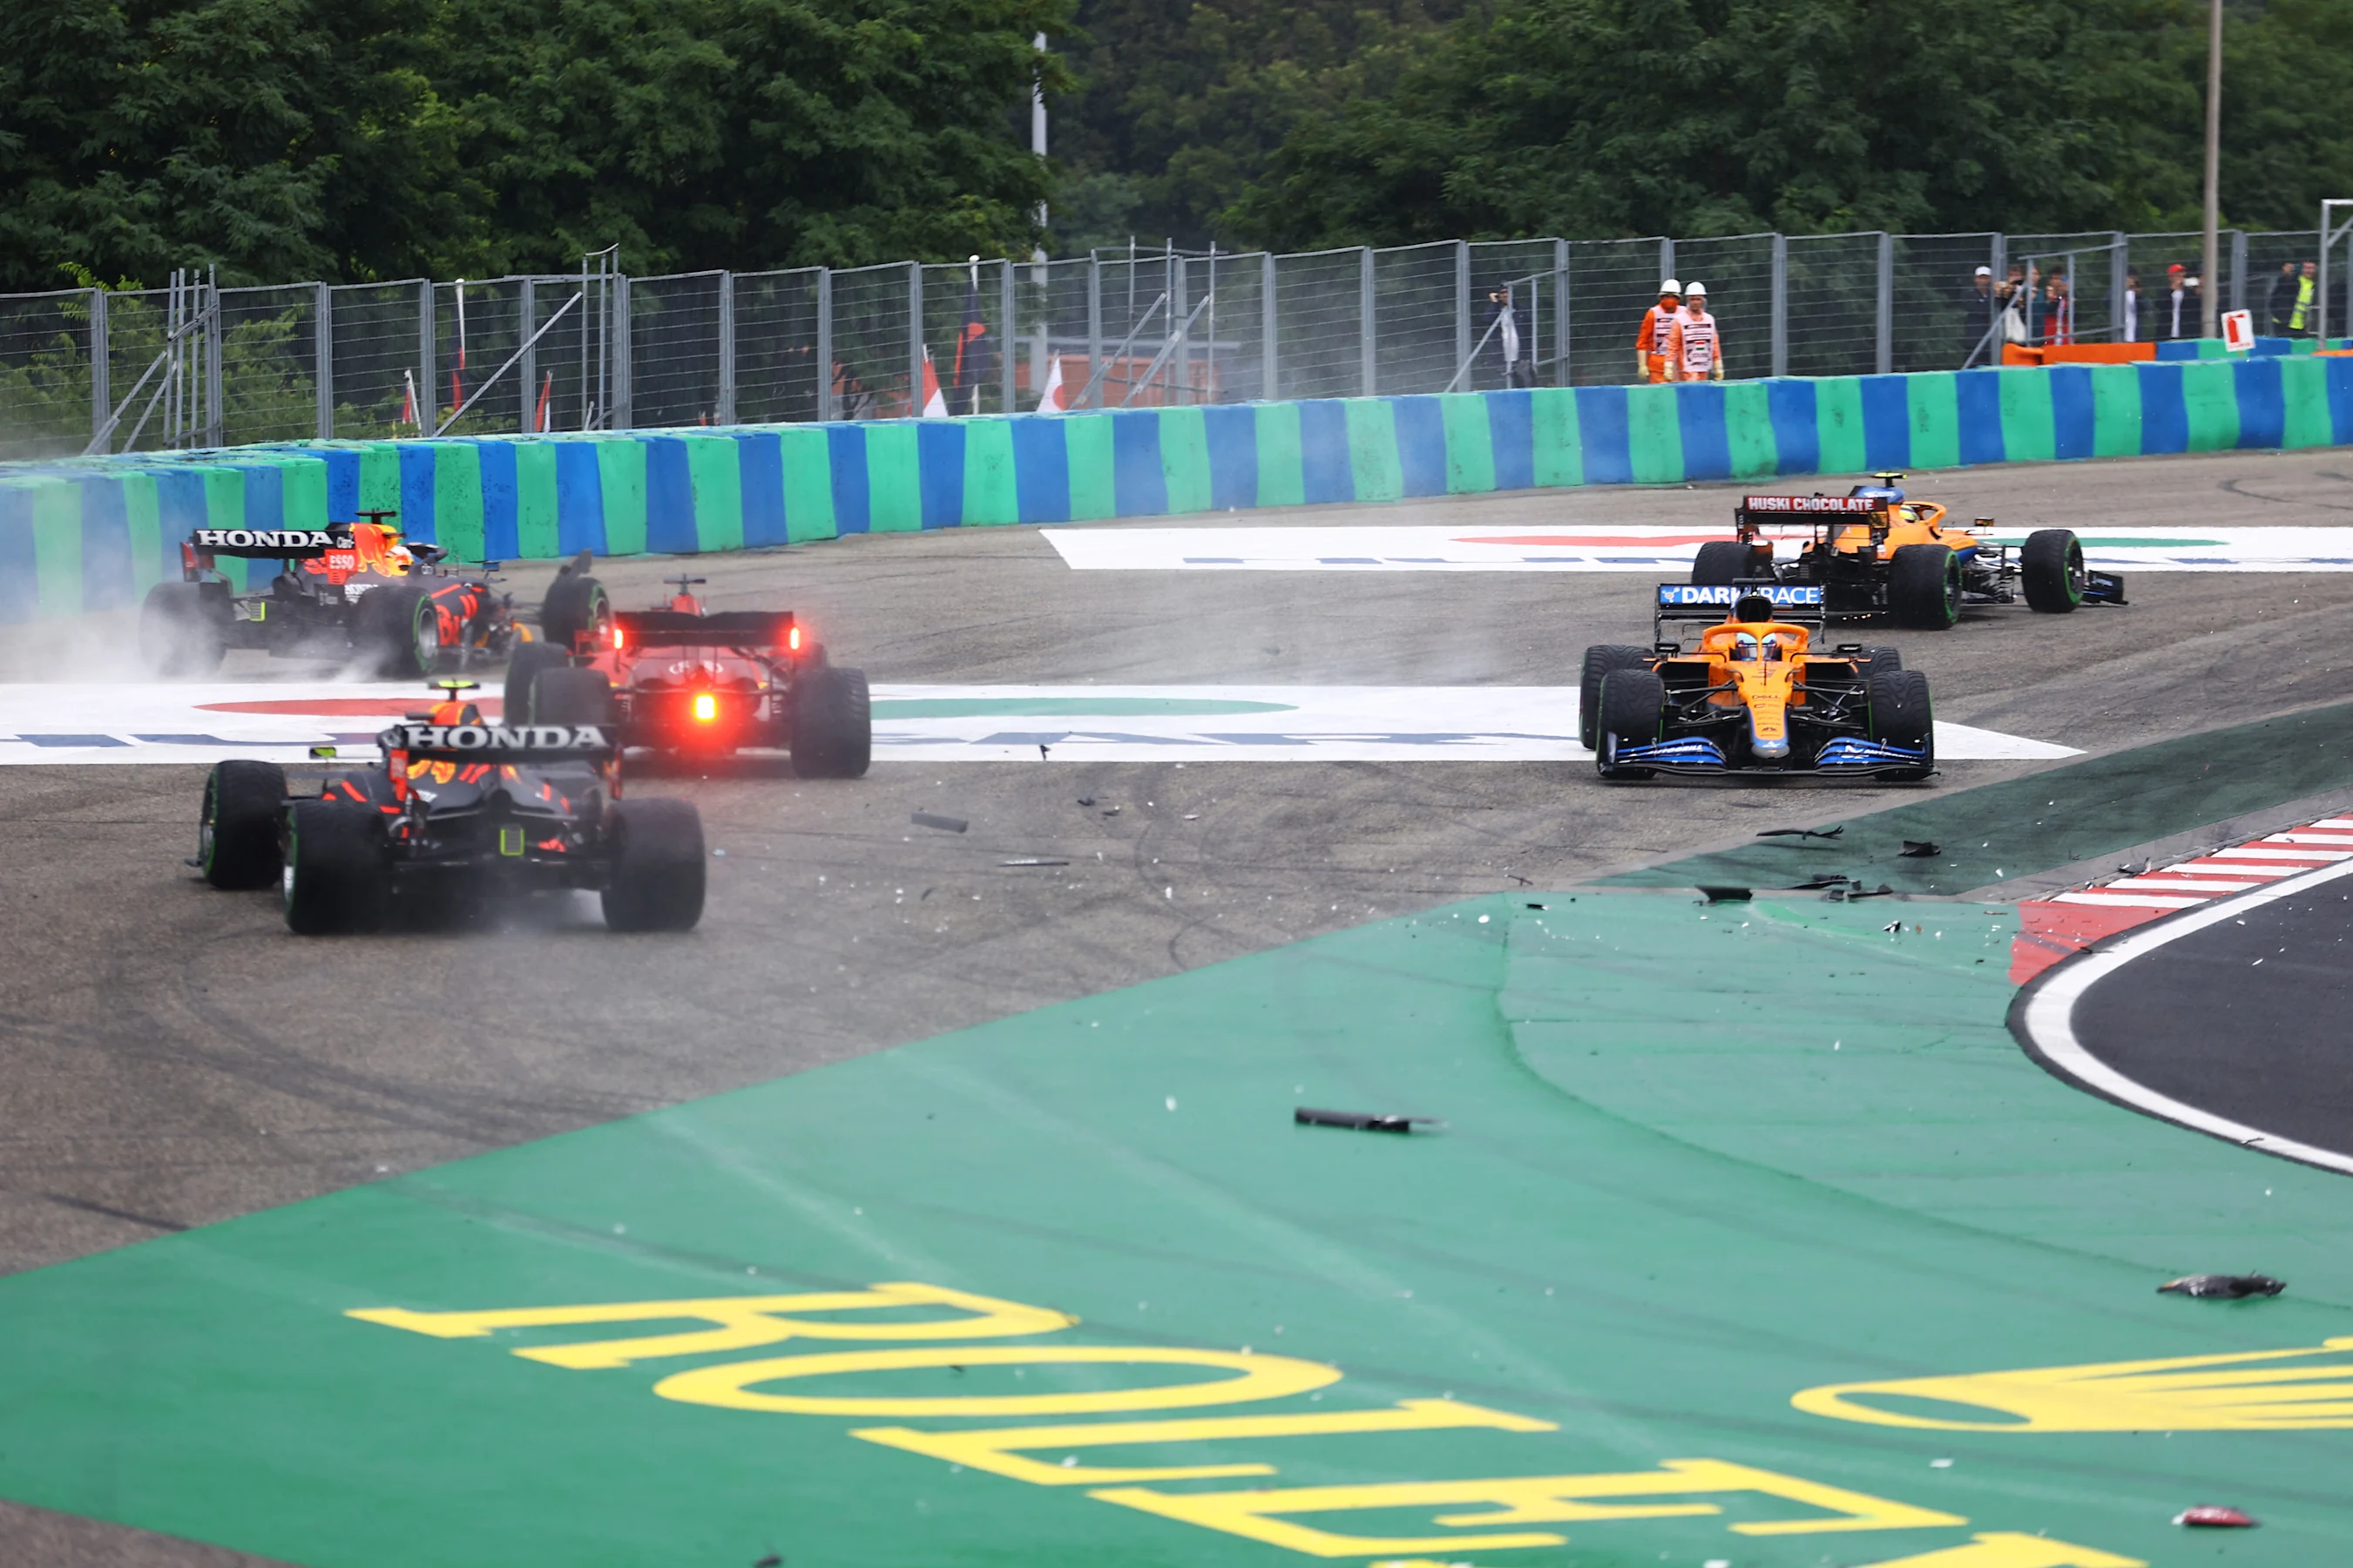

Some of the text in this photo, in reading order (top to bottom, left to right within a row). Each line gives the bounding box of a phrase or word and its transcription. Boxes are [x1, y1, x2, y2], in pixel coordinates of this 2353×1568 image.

[1748, 497, 1874, 512] HUSKI CHOCOLATE
[196, 530, 334, 548] HONDA
[1681, 587, 1819, 604] DARKRACE
[406, 726, 609, 749] HONDA
[344, 1281, 2148, 1568] ROLE
